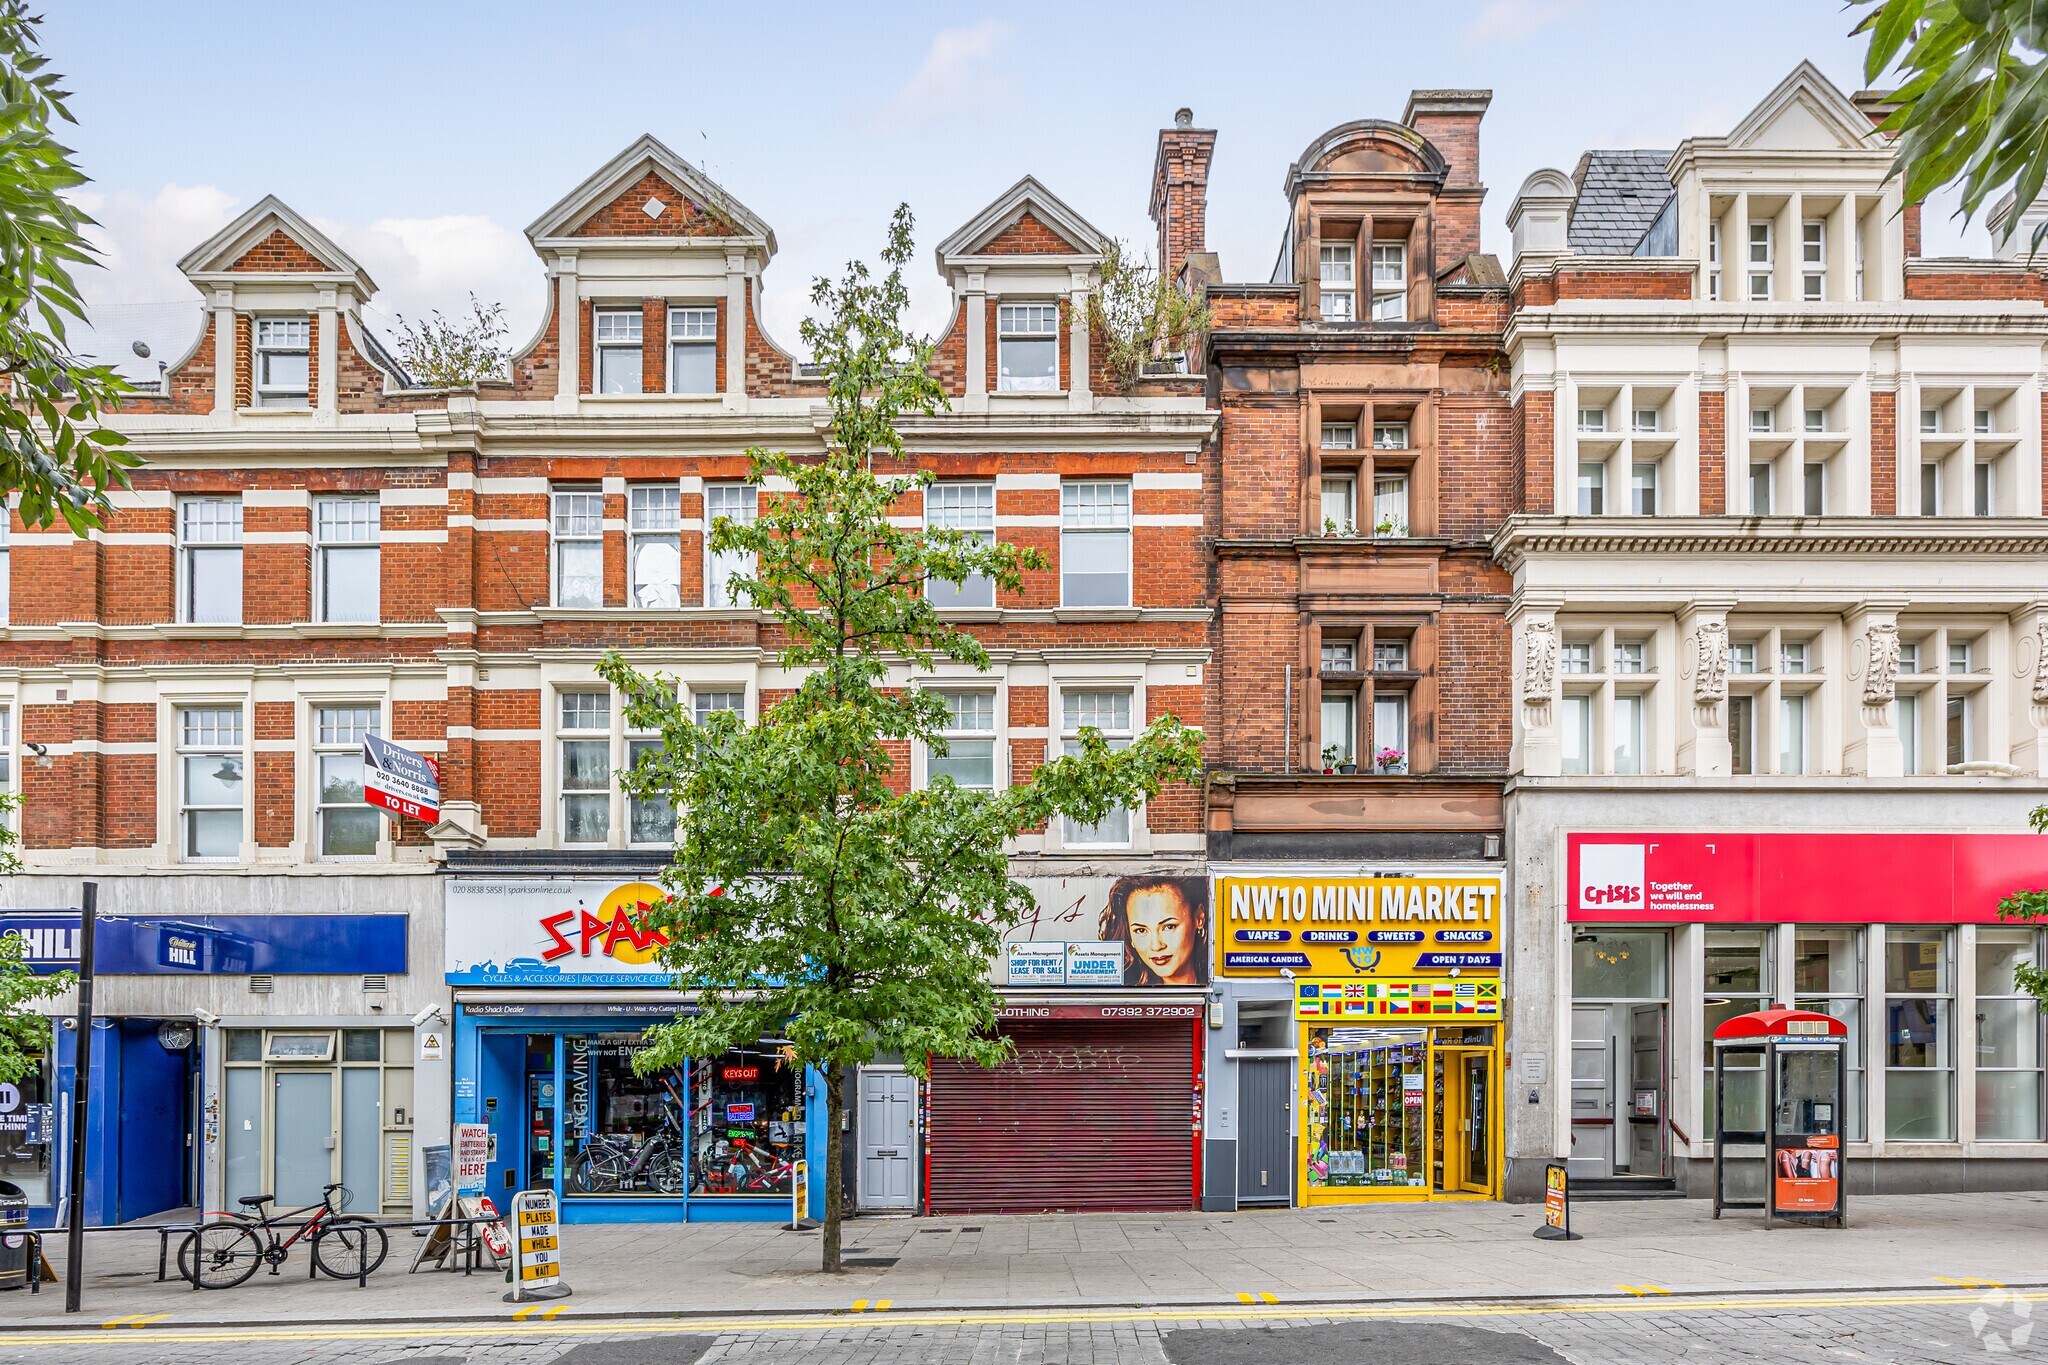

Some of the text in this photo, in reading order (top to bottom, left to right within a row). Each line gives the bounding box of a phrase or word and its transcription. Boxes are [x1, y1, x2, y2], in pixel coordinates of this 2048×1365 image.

[383, 743, 422, 769] Drivers
[376, 771, 428, 796] 020 3640 8888
[384, 784, 420, 800] drivers.co.uk
[385, 795, 420, 816] TO LET
[508, 885, 572, 895] sparksonline.co.uk
[1650, 882, 1693, 891] Together
[1665, 892, 1682, 900] will
[1684, 892, 1702, 900] end
[1231, 884, 1496, 921] NW10 MINI MARKET
[1650, 902, 1714, 910] homelessness
[1247, 931, 1484, 940] VAPES DRINKS SWEETS SNACKS
[1352, 946, 1374, 955] NW
[169, 947, 196, 965] HILL
[1357, 956, 1372, 964] 10
[994, 1008, 1195, 1016] CLOTHING 07392 372902
[724, 1069, 742, 1078] KEYS
[573, 1040, 589, 1138] ENGRAVING
[461, 1128, 486, 1138] WATCH
[460, 1163, 485, 1176] HERE
[526, 1199, 550, 1210] NUMBER
[526, 1212, 551, 1223] PLATES
[532, 1226, 549, 1236] MADE
[532, 1239, 550, 1250] WHILE
[535, 1252, 548, 1263] YOU
[535, 1266, 549, 1276] WAIT
